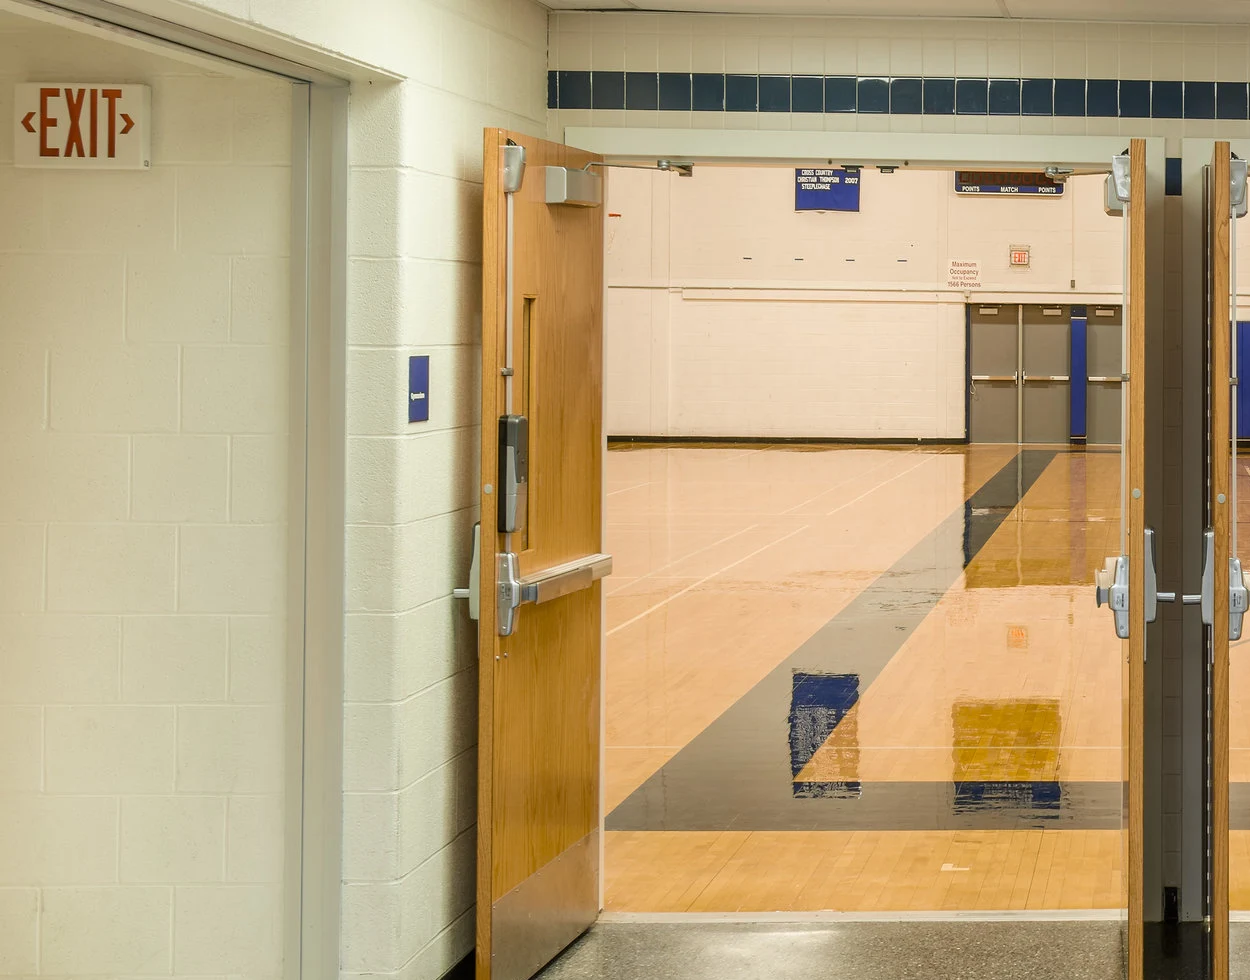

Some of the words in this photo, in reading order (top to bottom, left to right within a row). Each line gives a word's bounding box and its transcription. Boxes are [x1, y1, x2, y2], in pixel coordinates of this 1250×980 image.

[39, 87, 122, 158] EXIT
[1014, 252, 1026, 263] EXIT
[949, 268, 979, 276] Occupancy
